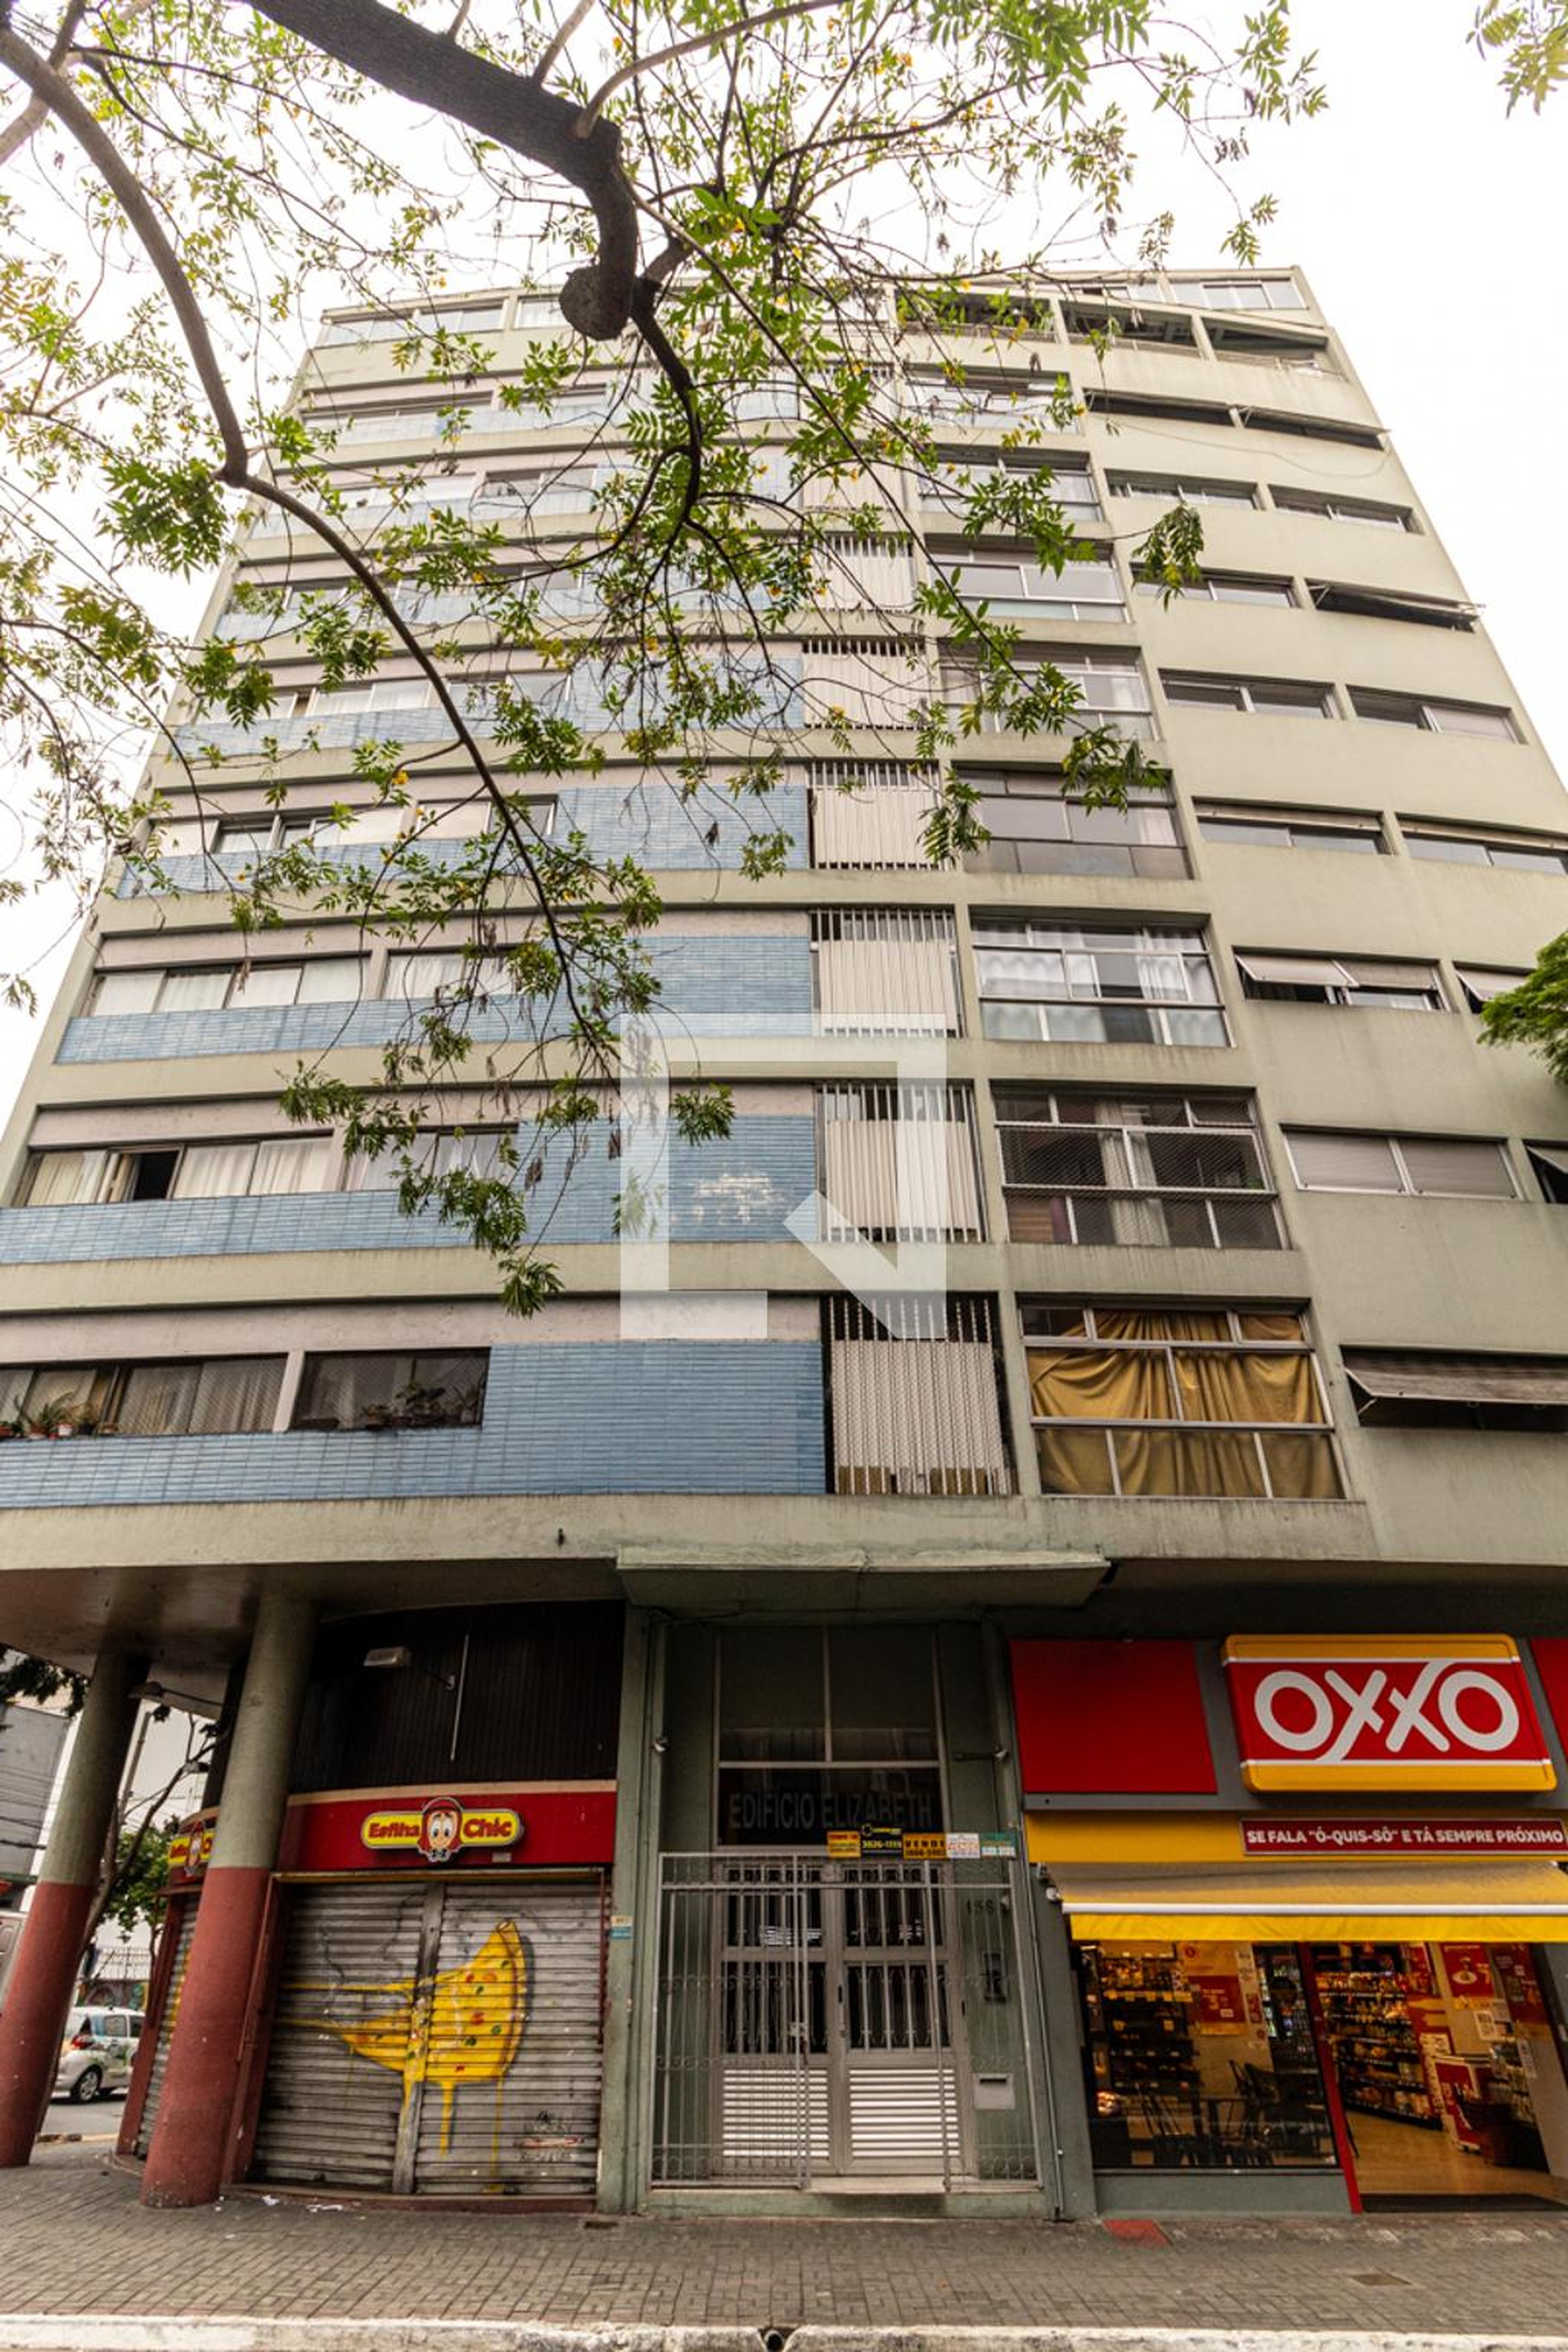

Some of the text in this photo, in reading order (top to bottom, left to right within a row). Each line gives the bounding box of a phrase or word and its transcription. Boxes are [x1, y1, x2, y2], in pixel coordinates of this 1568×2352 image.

[1254, 1661, 1520, 1761] OXXO
[821, 1792, 932, 1829] ELIZABETH
[463, 1817, 512, 1838] Chic
[1247, 1830, 1266, 1843] SE
[1267, 1830, 1307, 1843] FALA
[1401, 1829, 1412, 1842] E
[1413, 1826, 1435, 1842] TÁ
[1435, 1829, 1494, 1842] SEMPRE
[1495, 1826, 1564, 1842] PRÓXIMO
